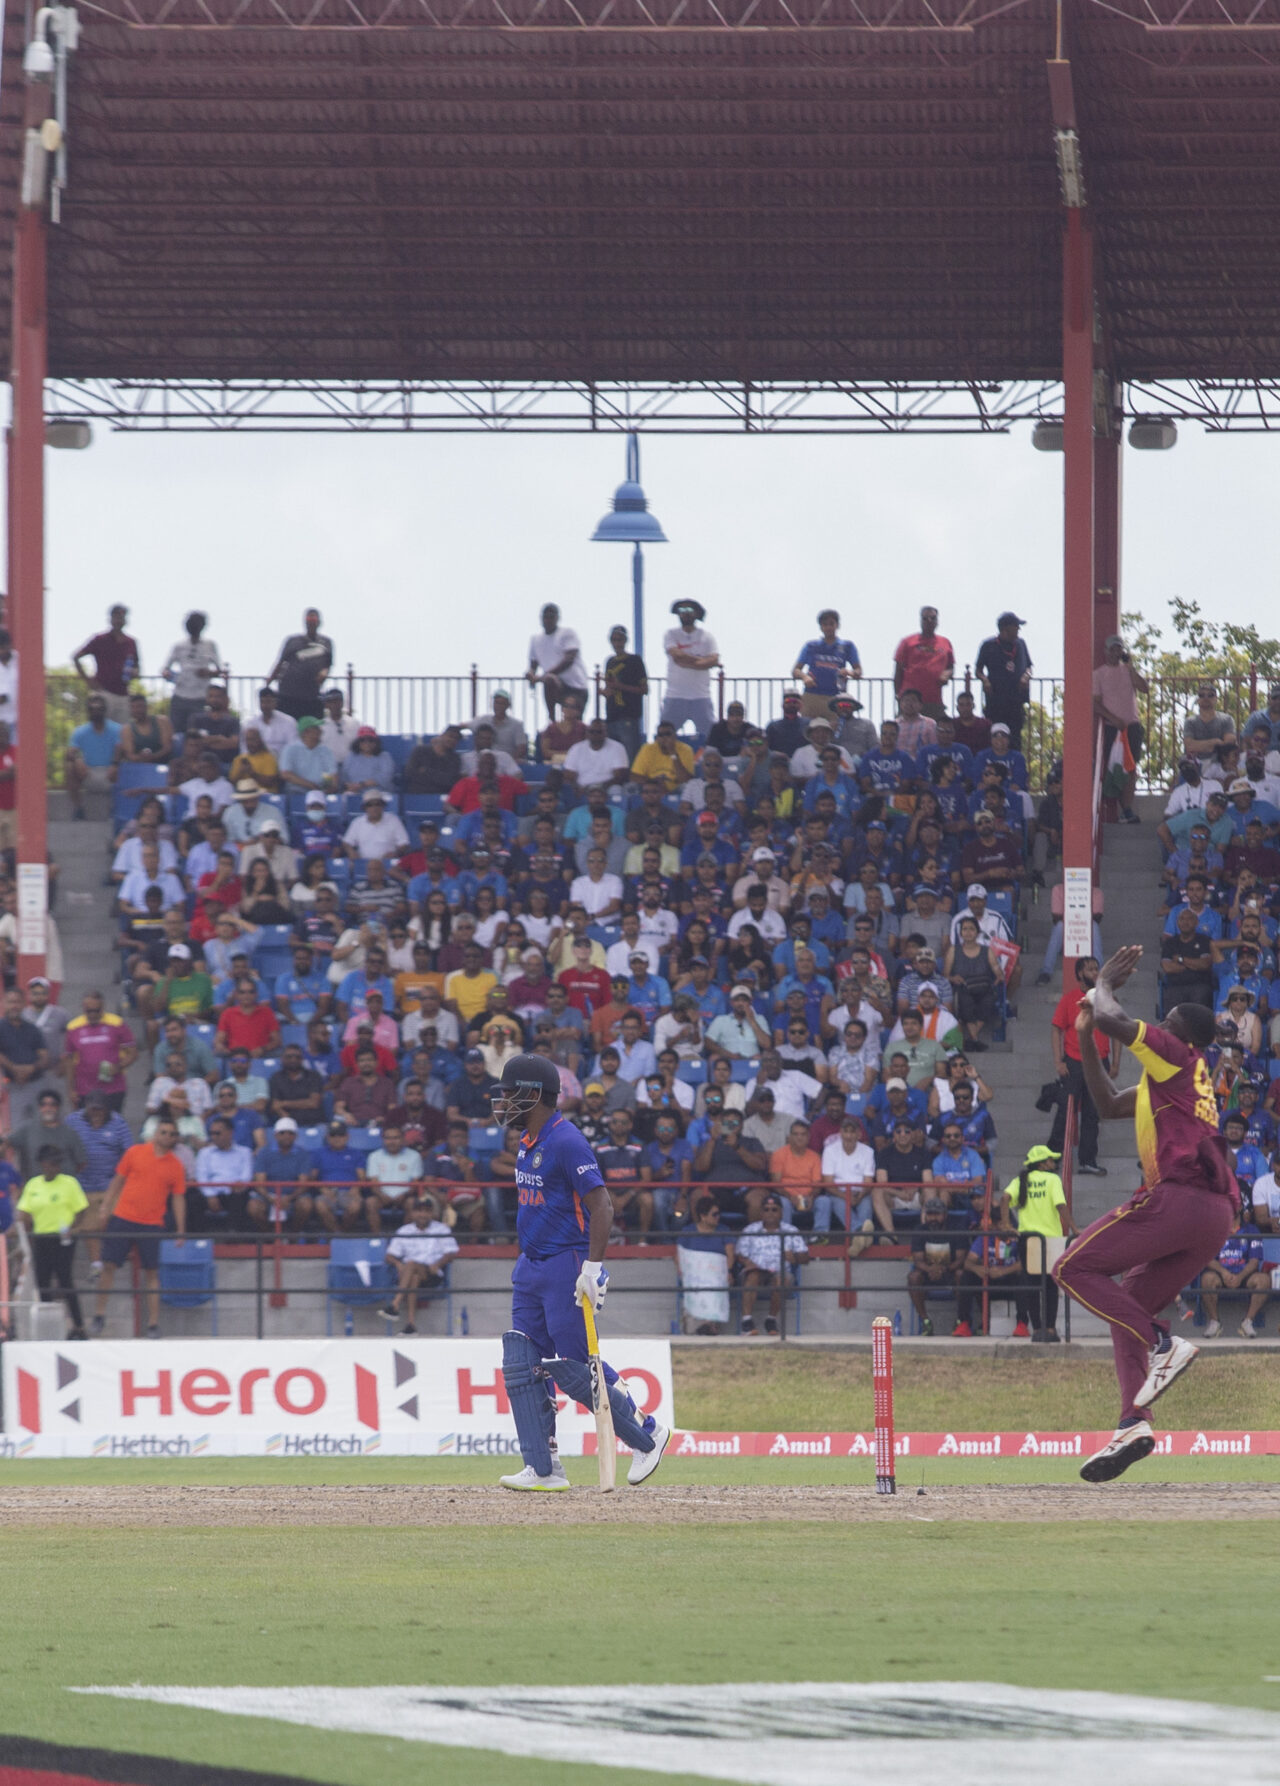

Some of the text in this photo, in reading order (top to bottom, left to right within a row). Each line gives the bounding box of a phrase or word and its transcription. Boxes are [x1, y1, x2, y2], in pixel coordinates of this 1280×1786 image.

[518, 1187, 545, 1206] DIA
[121, 1367, 327, 1416] Hero
[457, 1368, 662, 1416] Ho
[111, 1434, 190, 1454] Hettich
[284, 1433, 362, 1454] Hettich
[456, 1433, 521, 1453] Hettic
[677, 1434, 740, 1455] Amul
[769, 1434, 831, 1455] Amul
[938, 1433, 1000, 1455] Amul
[1019, 1433, 1081, 1455] Amul
[1190, 1433, 1250, 1455] Amul
